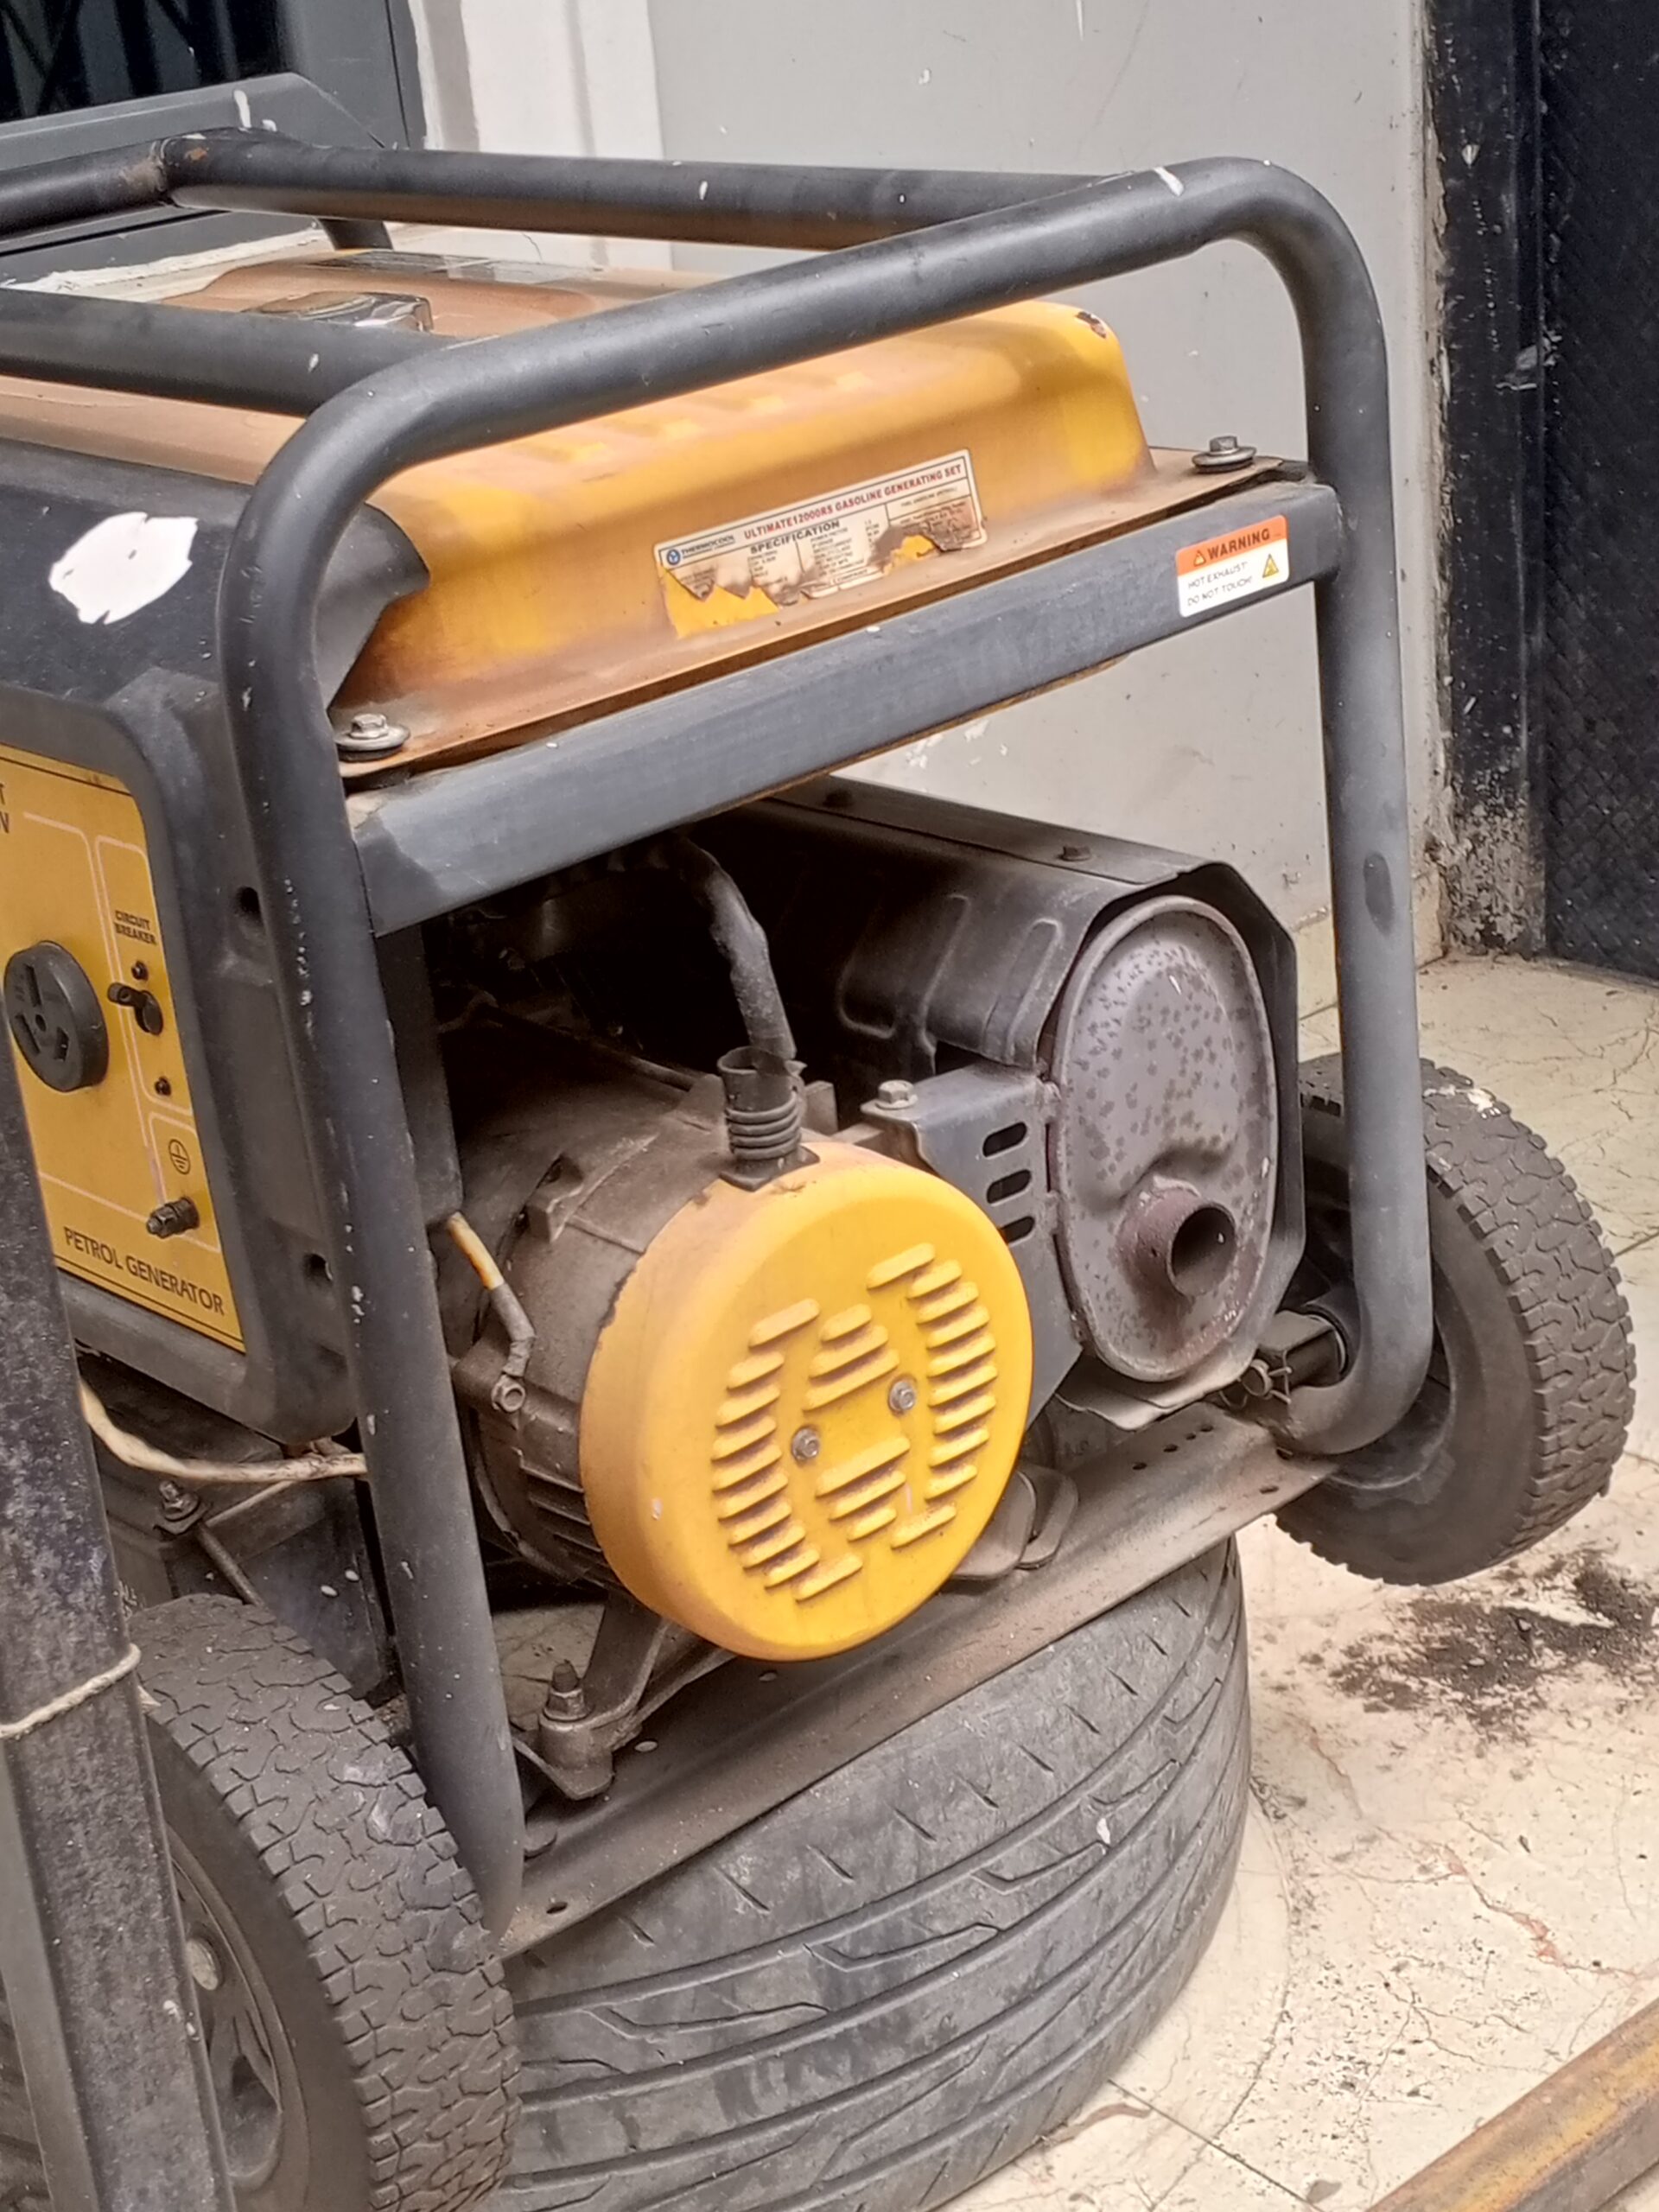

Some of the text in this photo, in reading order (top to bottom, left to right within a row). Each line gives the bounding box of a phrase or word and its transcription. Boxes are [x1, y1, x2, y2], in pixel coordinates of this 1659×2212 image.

[835, 488, 882, 512] GASOLINE
[884, 469, 944, 496] GENERATING
[944, 464, 962, 478] SET
[750, 519, 840, 554] SPECIFICATION
[1206, 528, 1270, 559] WARNING
[1188, 561, 1248, 589] HOT EXHAUST
[1187, 595, 1199, 607] DO
[1202, 588, 1219, 600] NOT
[114, 922, 157, 945] BREAKER
[115, 910, 150, 930] CIRCUIT
[63, 1226, 225, 1316] PETROL GENERATOR
